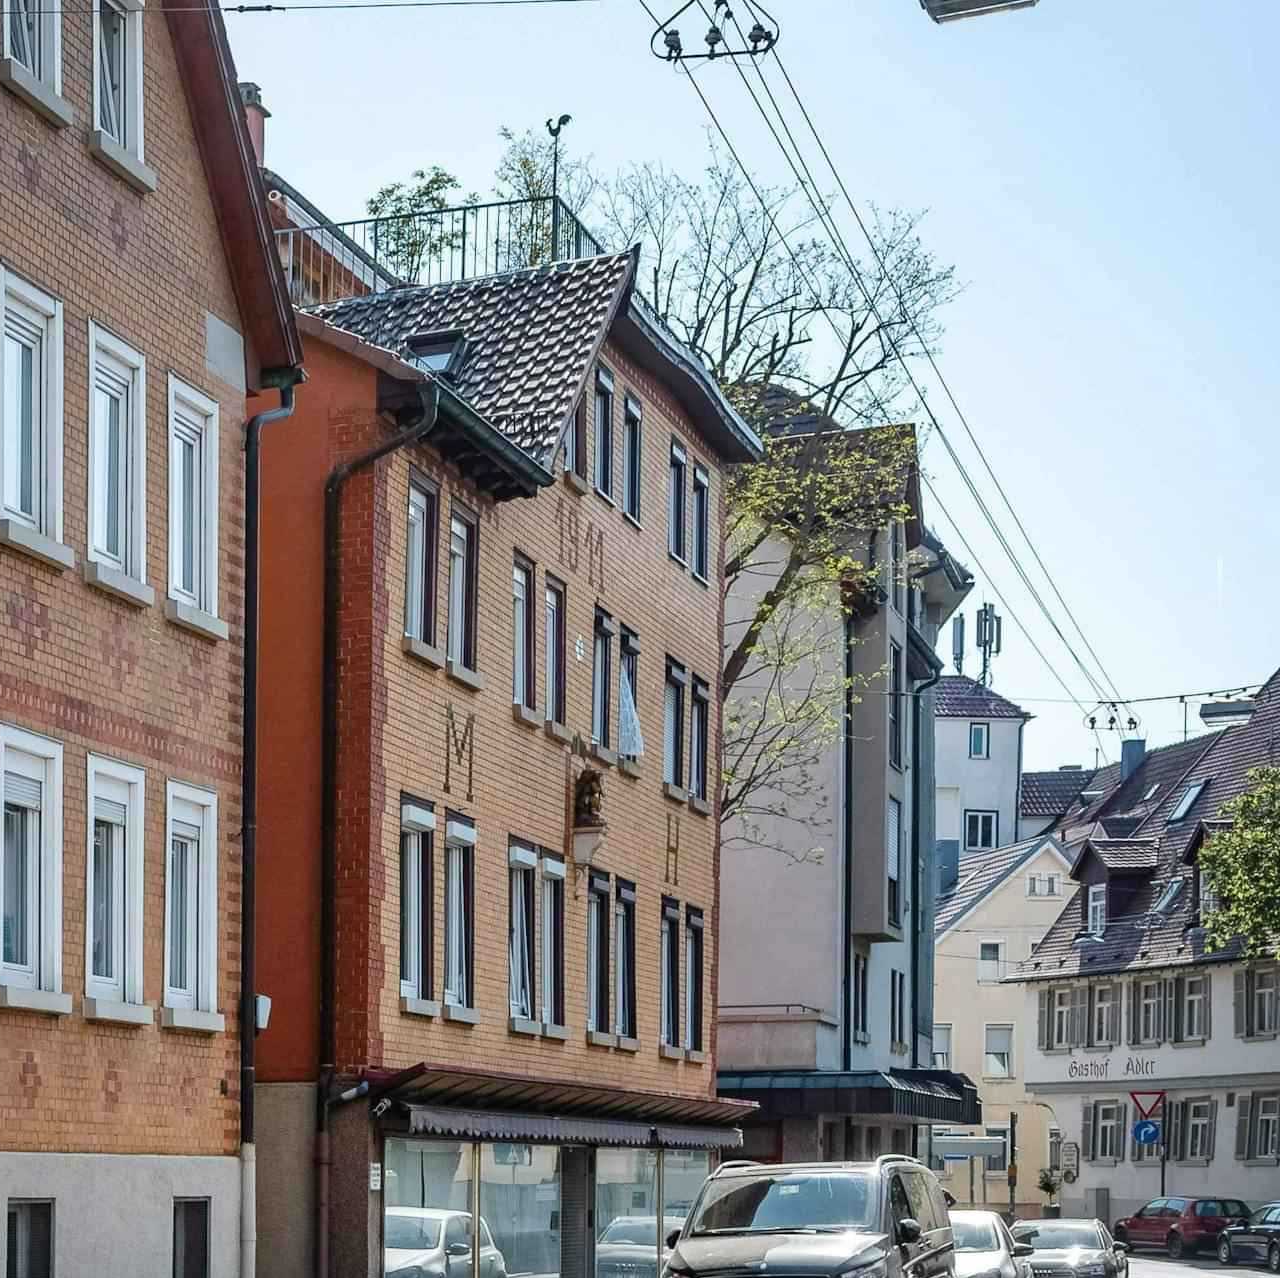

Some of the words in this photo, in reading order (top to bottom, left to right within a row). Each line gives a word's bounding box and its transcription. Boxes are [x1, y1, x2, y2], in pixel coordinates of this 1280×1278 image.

[443, 703, 475, 803] M
[664, 811, 681, 886] H
[1069, 1058, 1110, 1079] Gasthof
[1122, 1056, 1156, 1076] Adler
